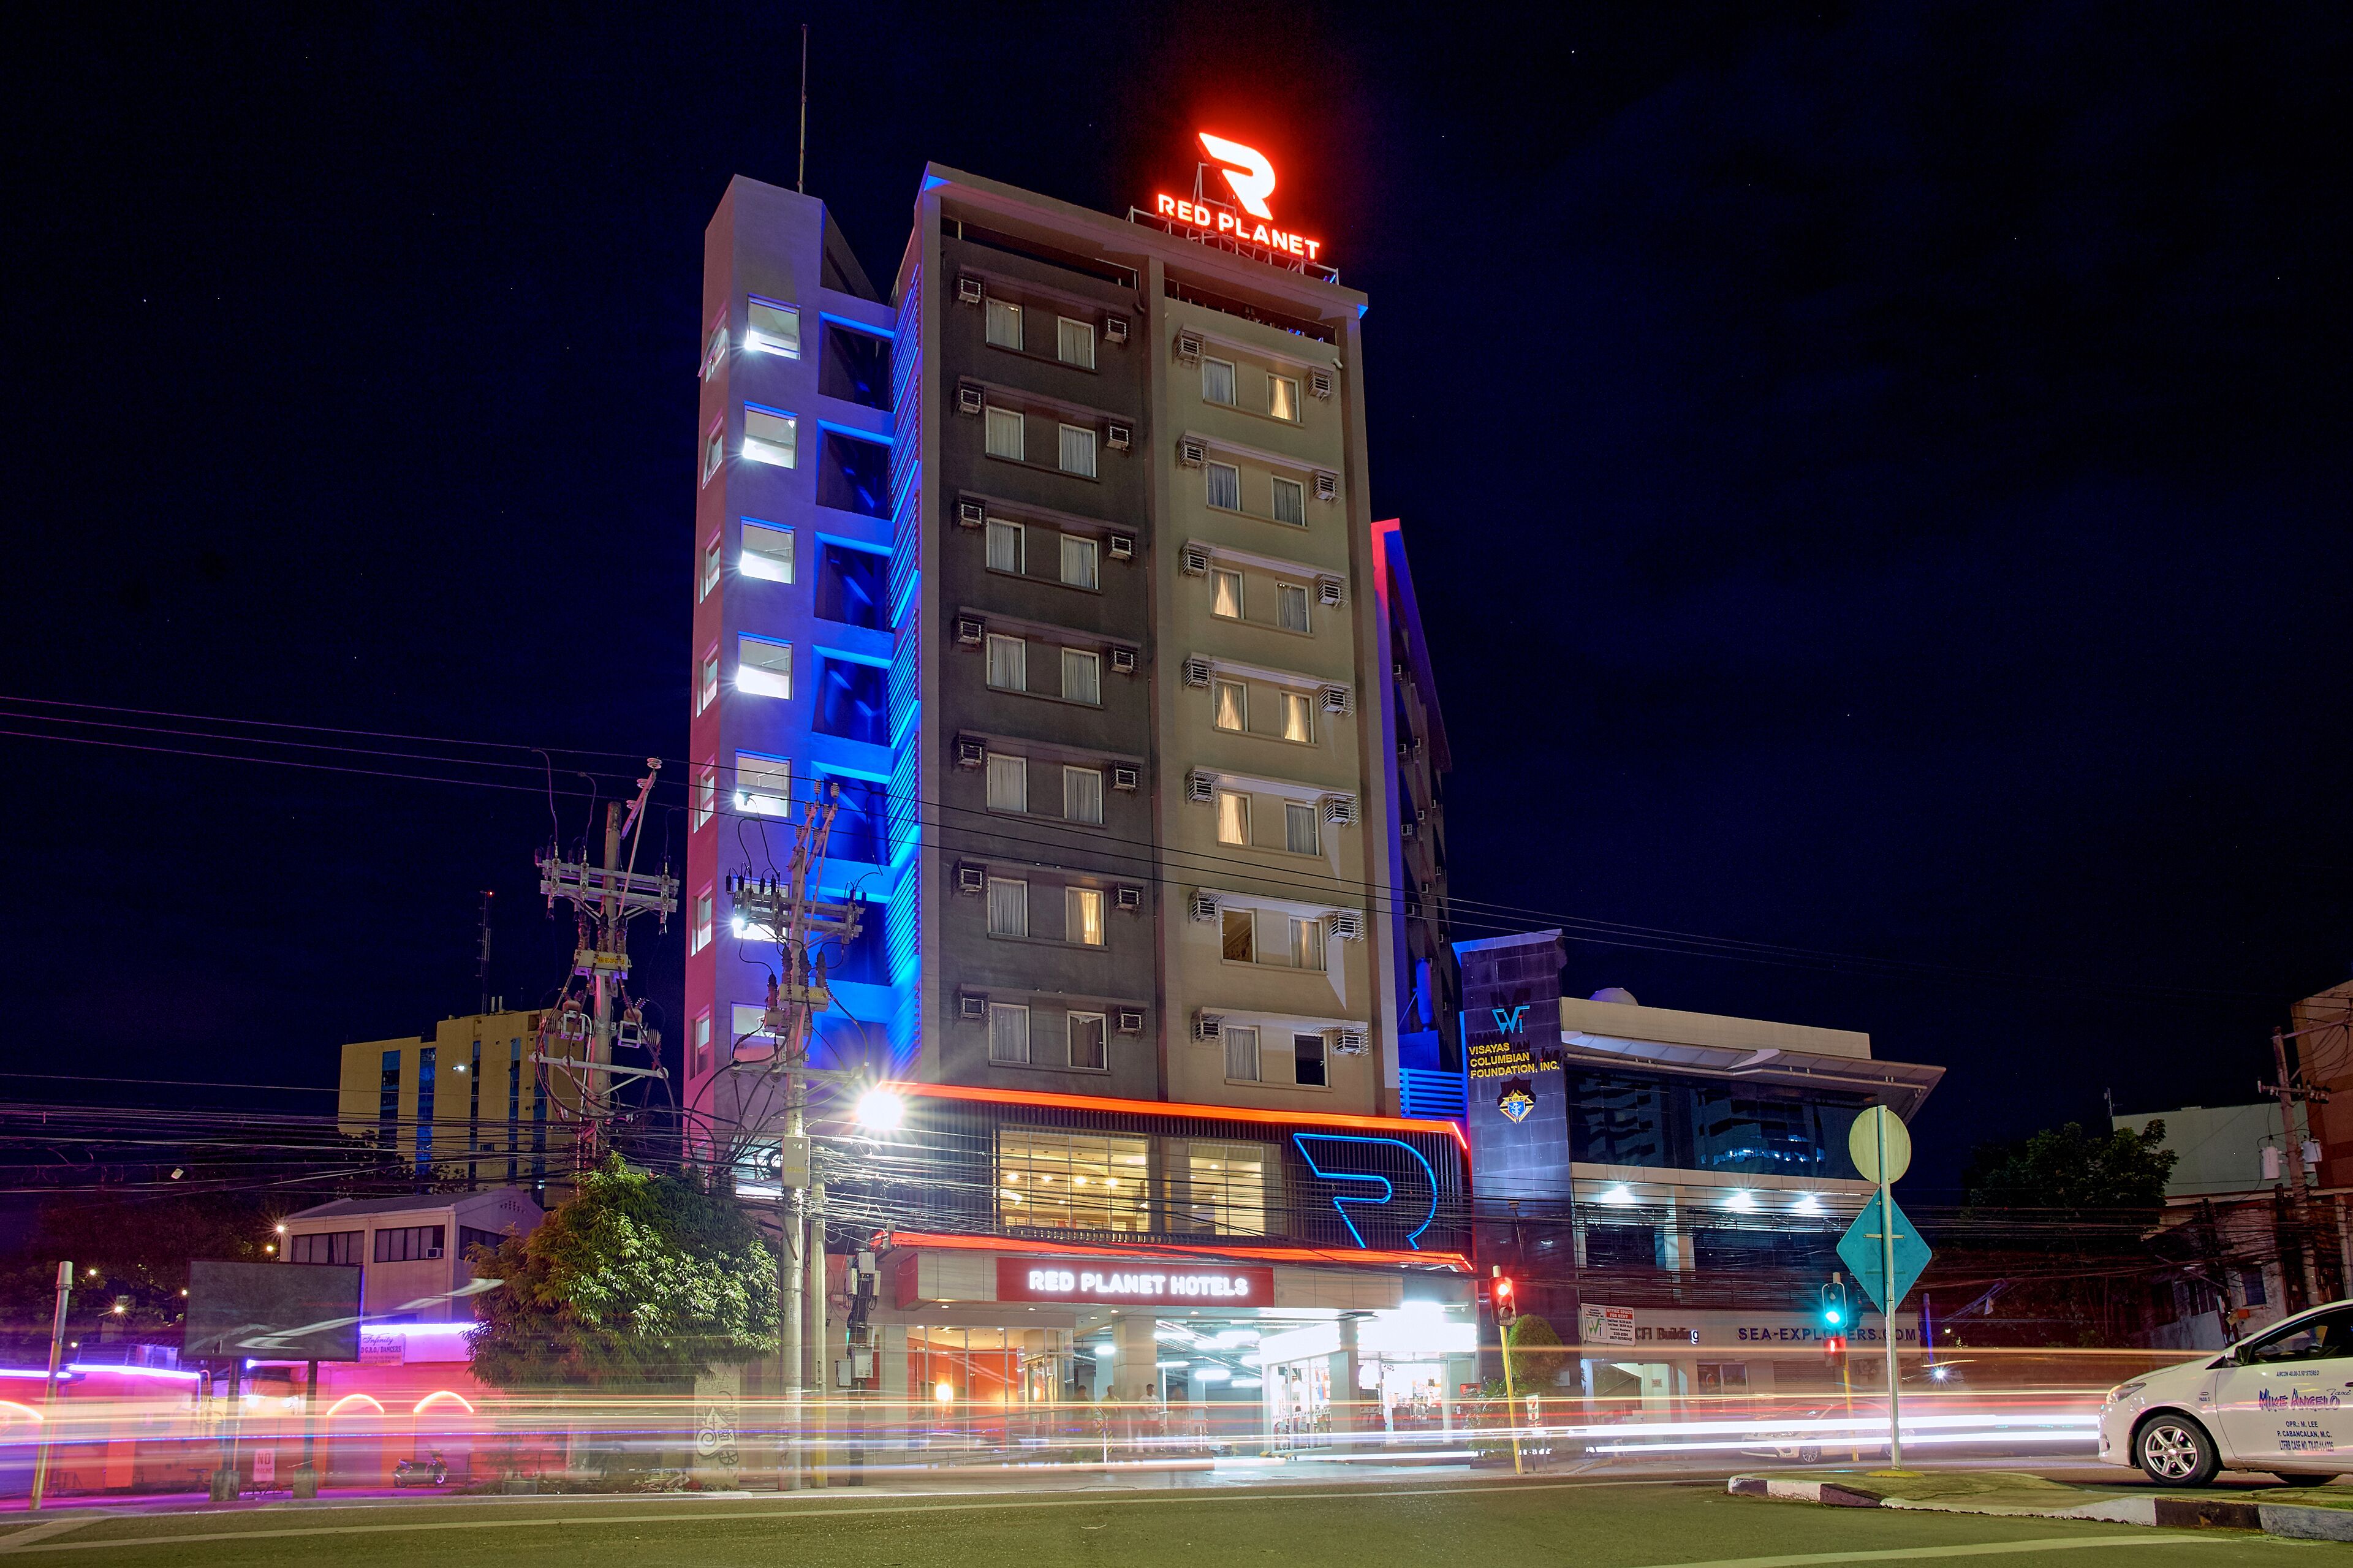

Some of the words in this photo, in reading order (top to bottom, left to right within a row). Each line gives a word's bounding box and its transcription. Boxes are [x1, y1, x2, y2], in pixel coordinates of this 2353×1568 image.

[1158, 194, 1211, 227] RED
[1218, 212, 1320, 259] PLANET
[1468, 1042, 1510, 1055] VISAYAS
[1470, 1052, 1530, 1067] COLUMBIAN
[1539, 1059, 1560, 1071] INC.
[1029, 1271, 1075, 1291] RED
[1081, 1273, 1166, 1294] PLANET
[1170, 1276, 1249, 1296] HOTELS
[2291, 1441, 2301, 1450] CASE
[258, 1453, 271, 1464] NO
